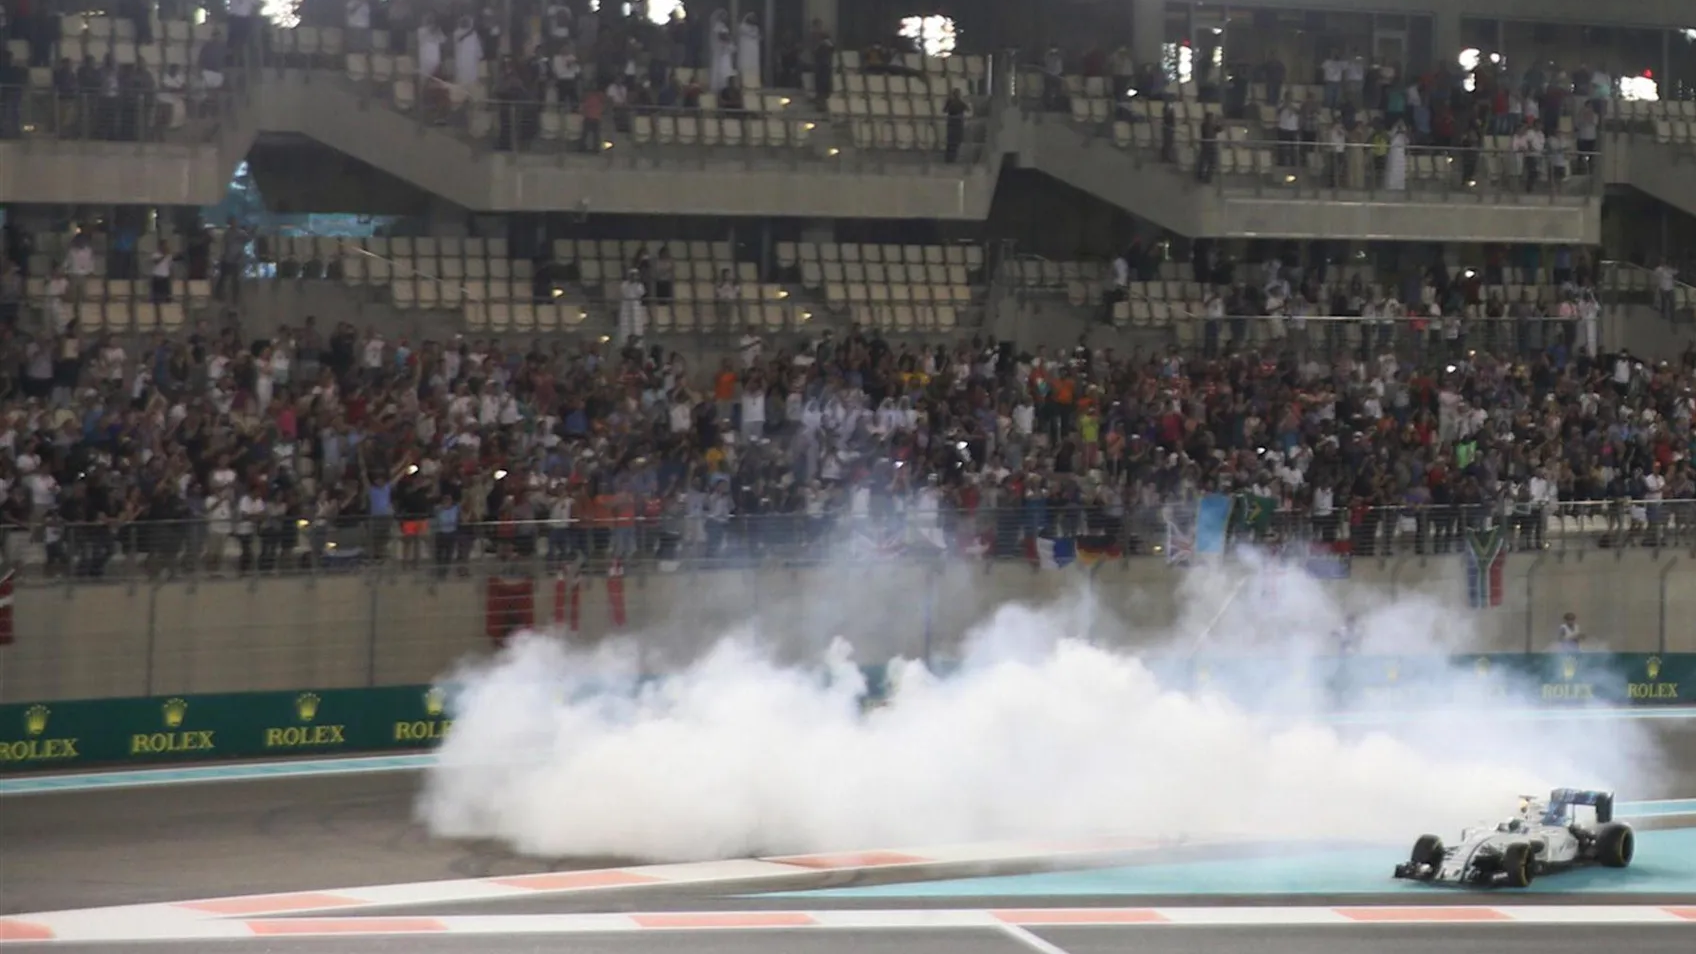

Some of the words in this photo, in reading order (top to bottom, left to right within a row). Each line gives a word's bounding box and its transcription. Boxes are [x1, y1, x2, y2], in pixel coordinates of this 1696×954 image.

[1628, 682, 1679, 698] ROLEX
[266, 725, 346, 746] ROLEX
[395, 720, 454, 740] ROLE
[133, 731, 215, 753] ROLEX
